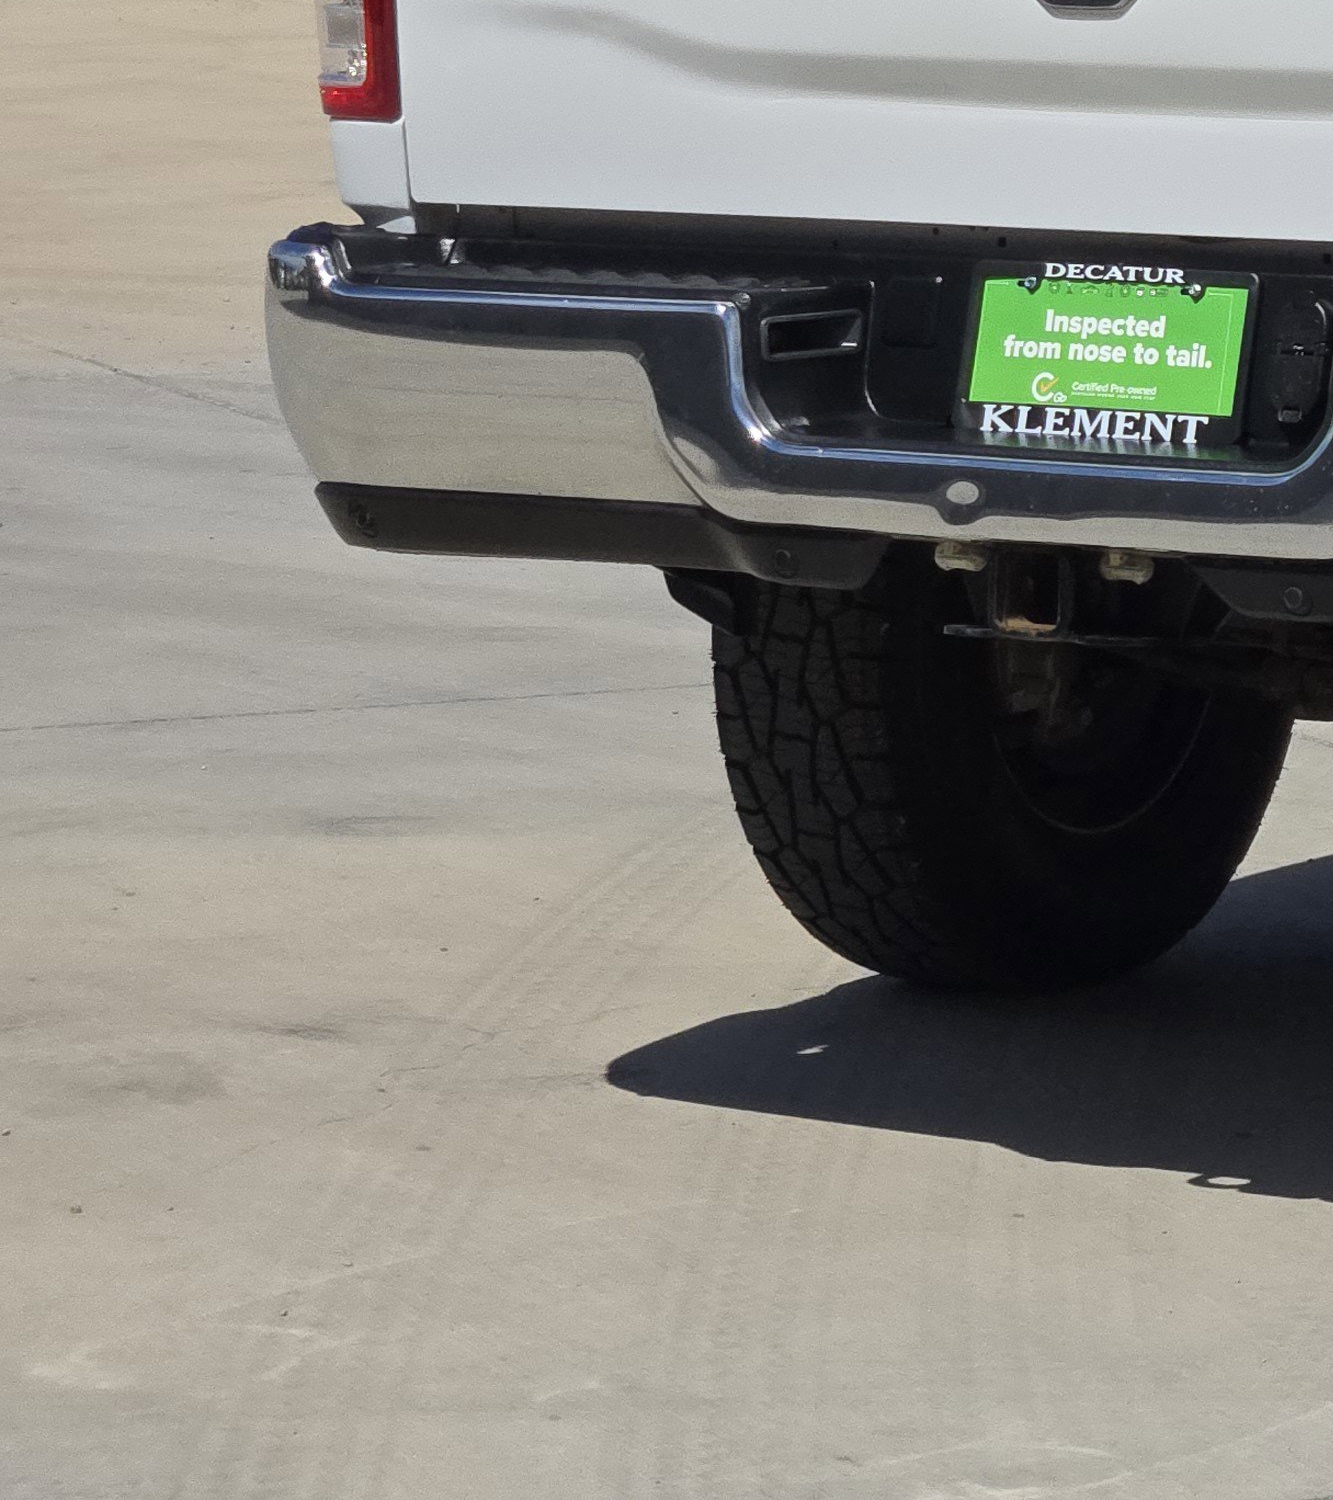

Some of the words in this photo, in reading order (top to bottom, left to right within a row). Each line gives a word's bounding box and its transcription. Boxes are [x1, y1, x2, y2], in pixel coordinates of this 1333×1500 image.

[1044, 262, 1186, 285] DECATUR
[1044, 308, 1167, 339] Inspected
[1003, 334, 1061, 360] from
[1067, 344, 1127, 364] nose
[1133, 344, 1160, 366] to
[1166, 343, 1213, 369] tail.
[1071, 381, 1109, 392] Certified
[980, 404, 1209, 444] KLEMENT
